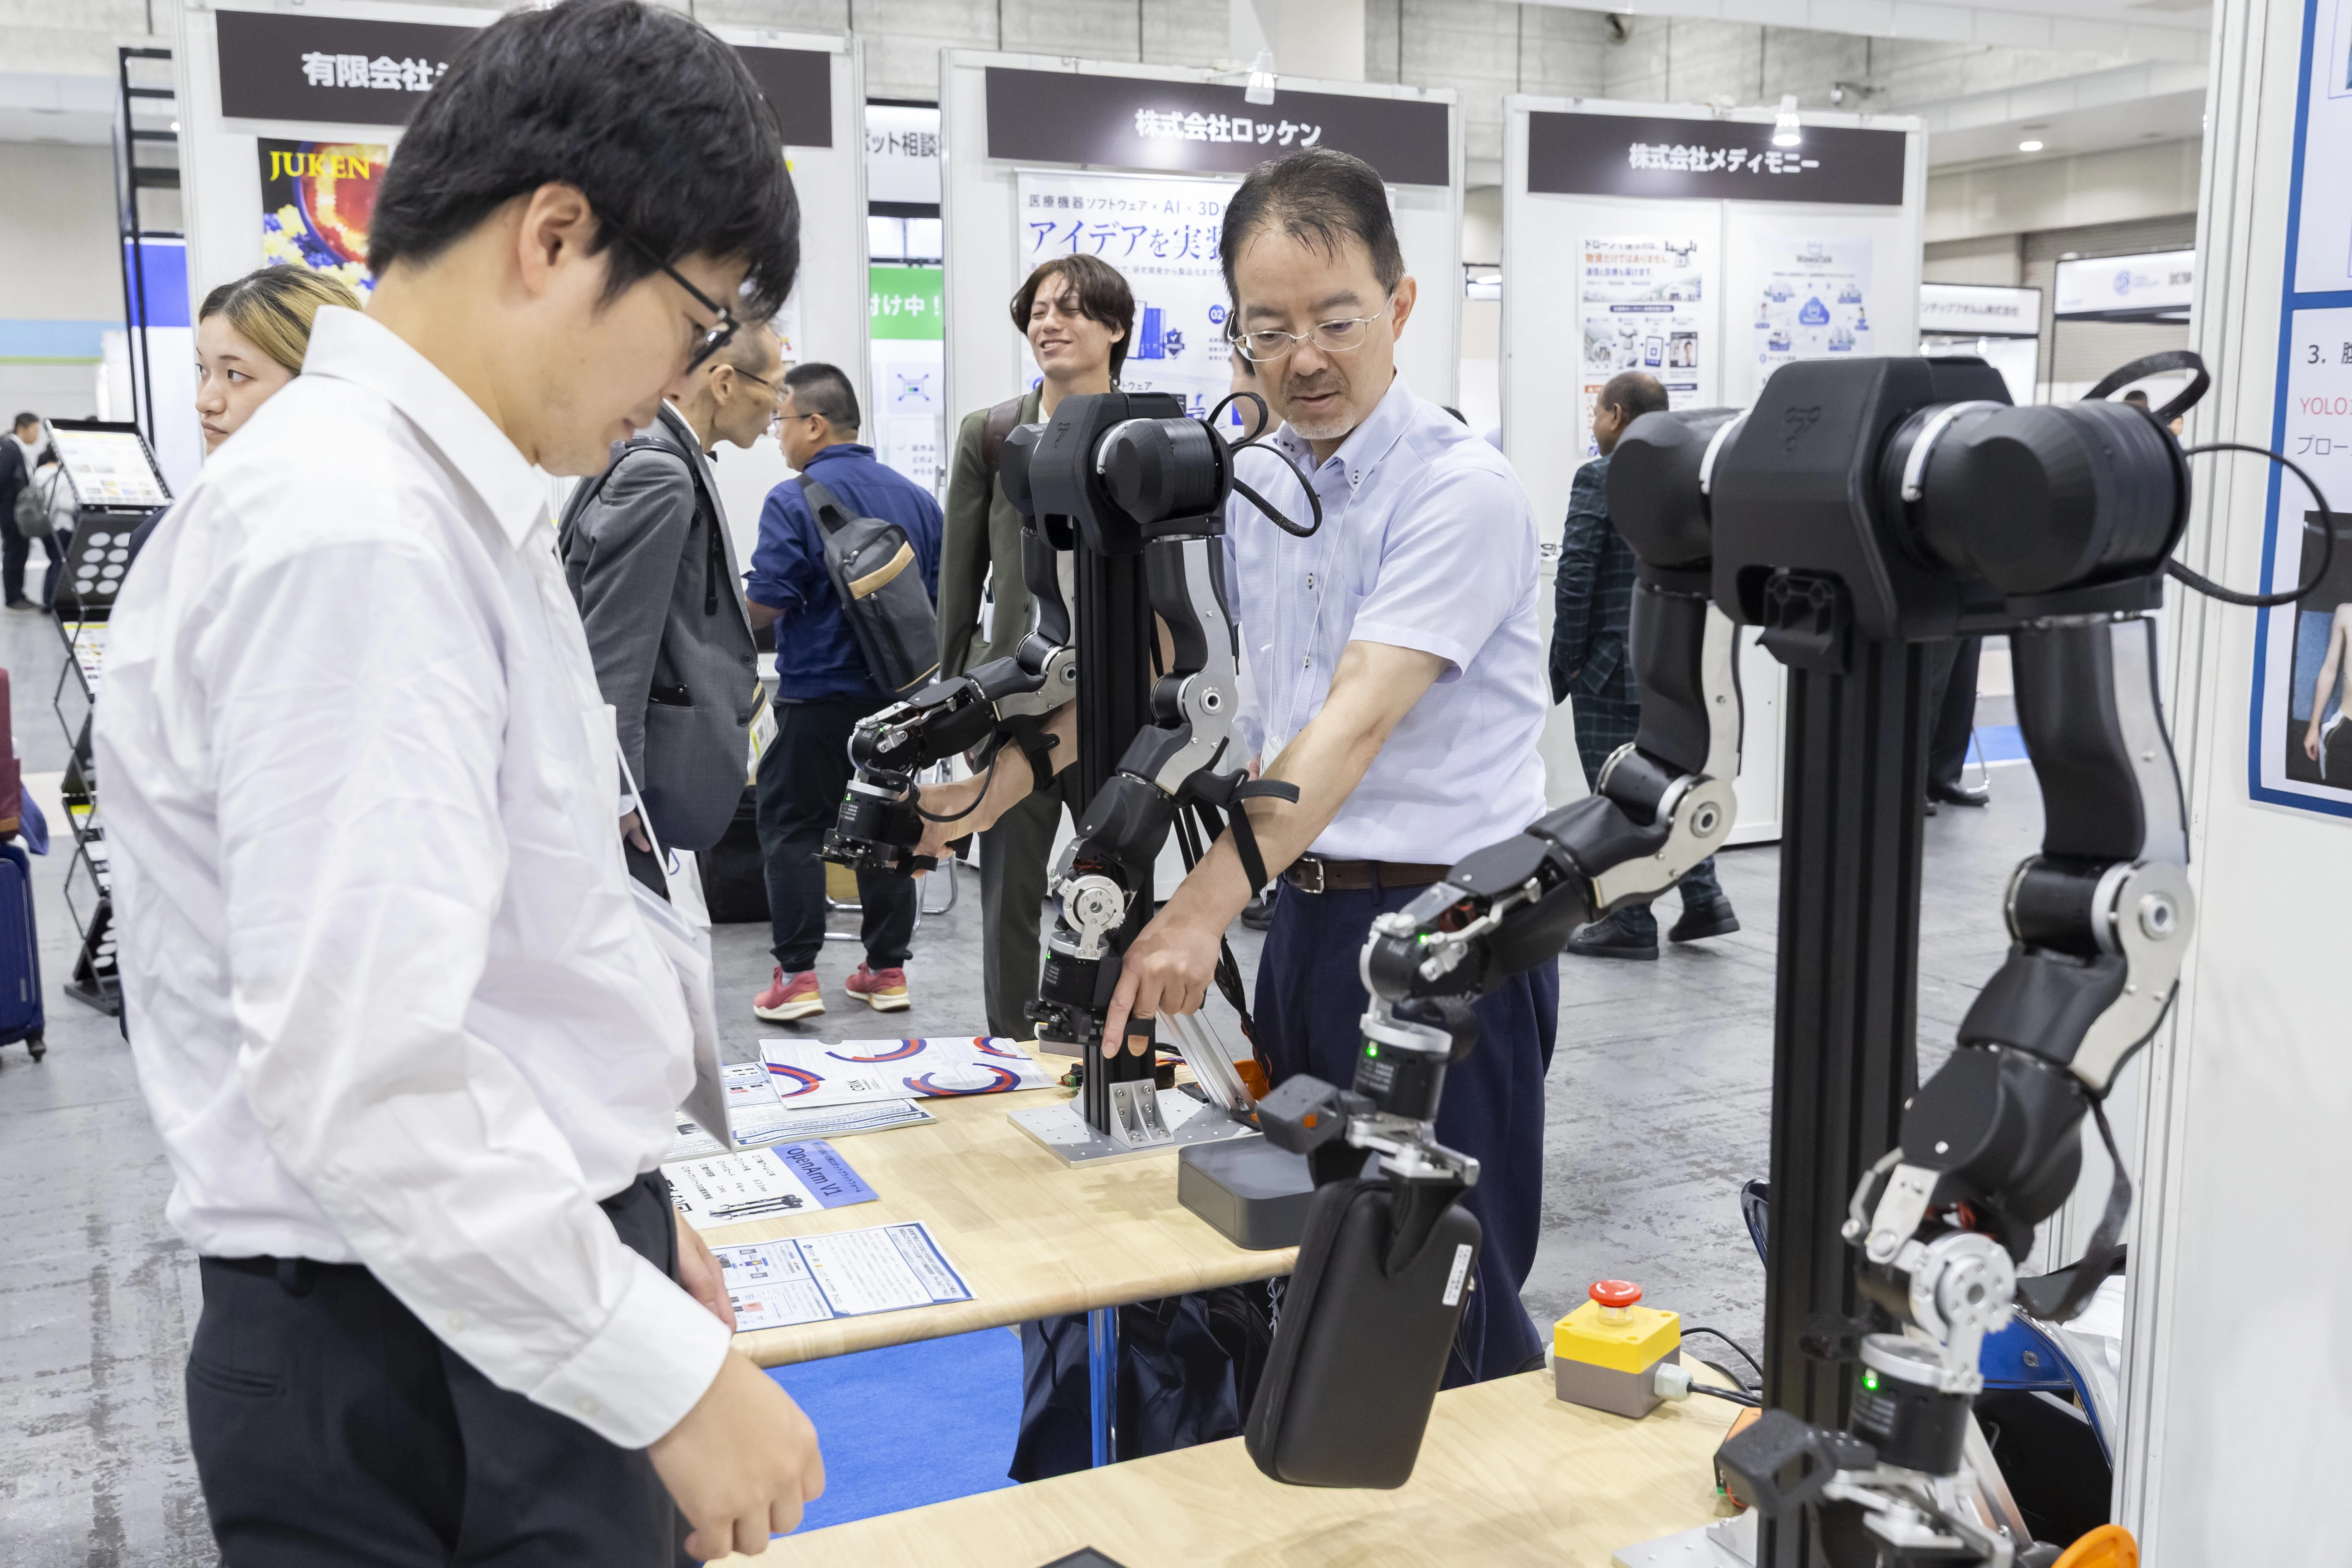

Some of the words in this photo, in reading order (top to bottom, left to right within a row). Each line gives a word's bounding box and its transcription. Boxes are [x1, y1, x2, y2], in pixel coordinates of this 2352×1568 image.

[1135, 108, 1321, 147] 株式会社ロッケン
[866, 129, 936, 157] ット相談
[1629, 142, 1820, 173] 株式会社メディモニー
[269, 150, 370, 181] JUKEN
[1029, 194, 1148, 211] 医療機器ソフトウェア
[1198, 201, 1220, 216] 3D
[1210, 309, 1224, 320] 02
[2297, 434, 2352, 455] プロー
[786, 1148, 828, 1184] OpenArm
[820, 1183, 843, 1196] V1
